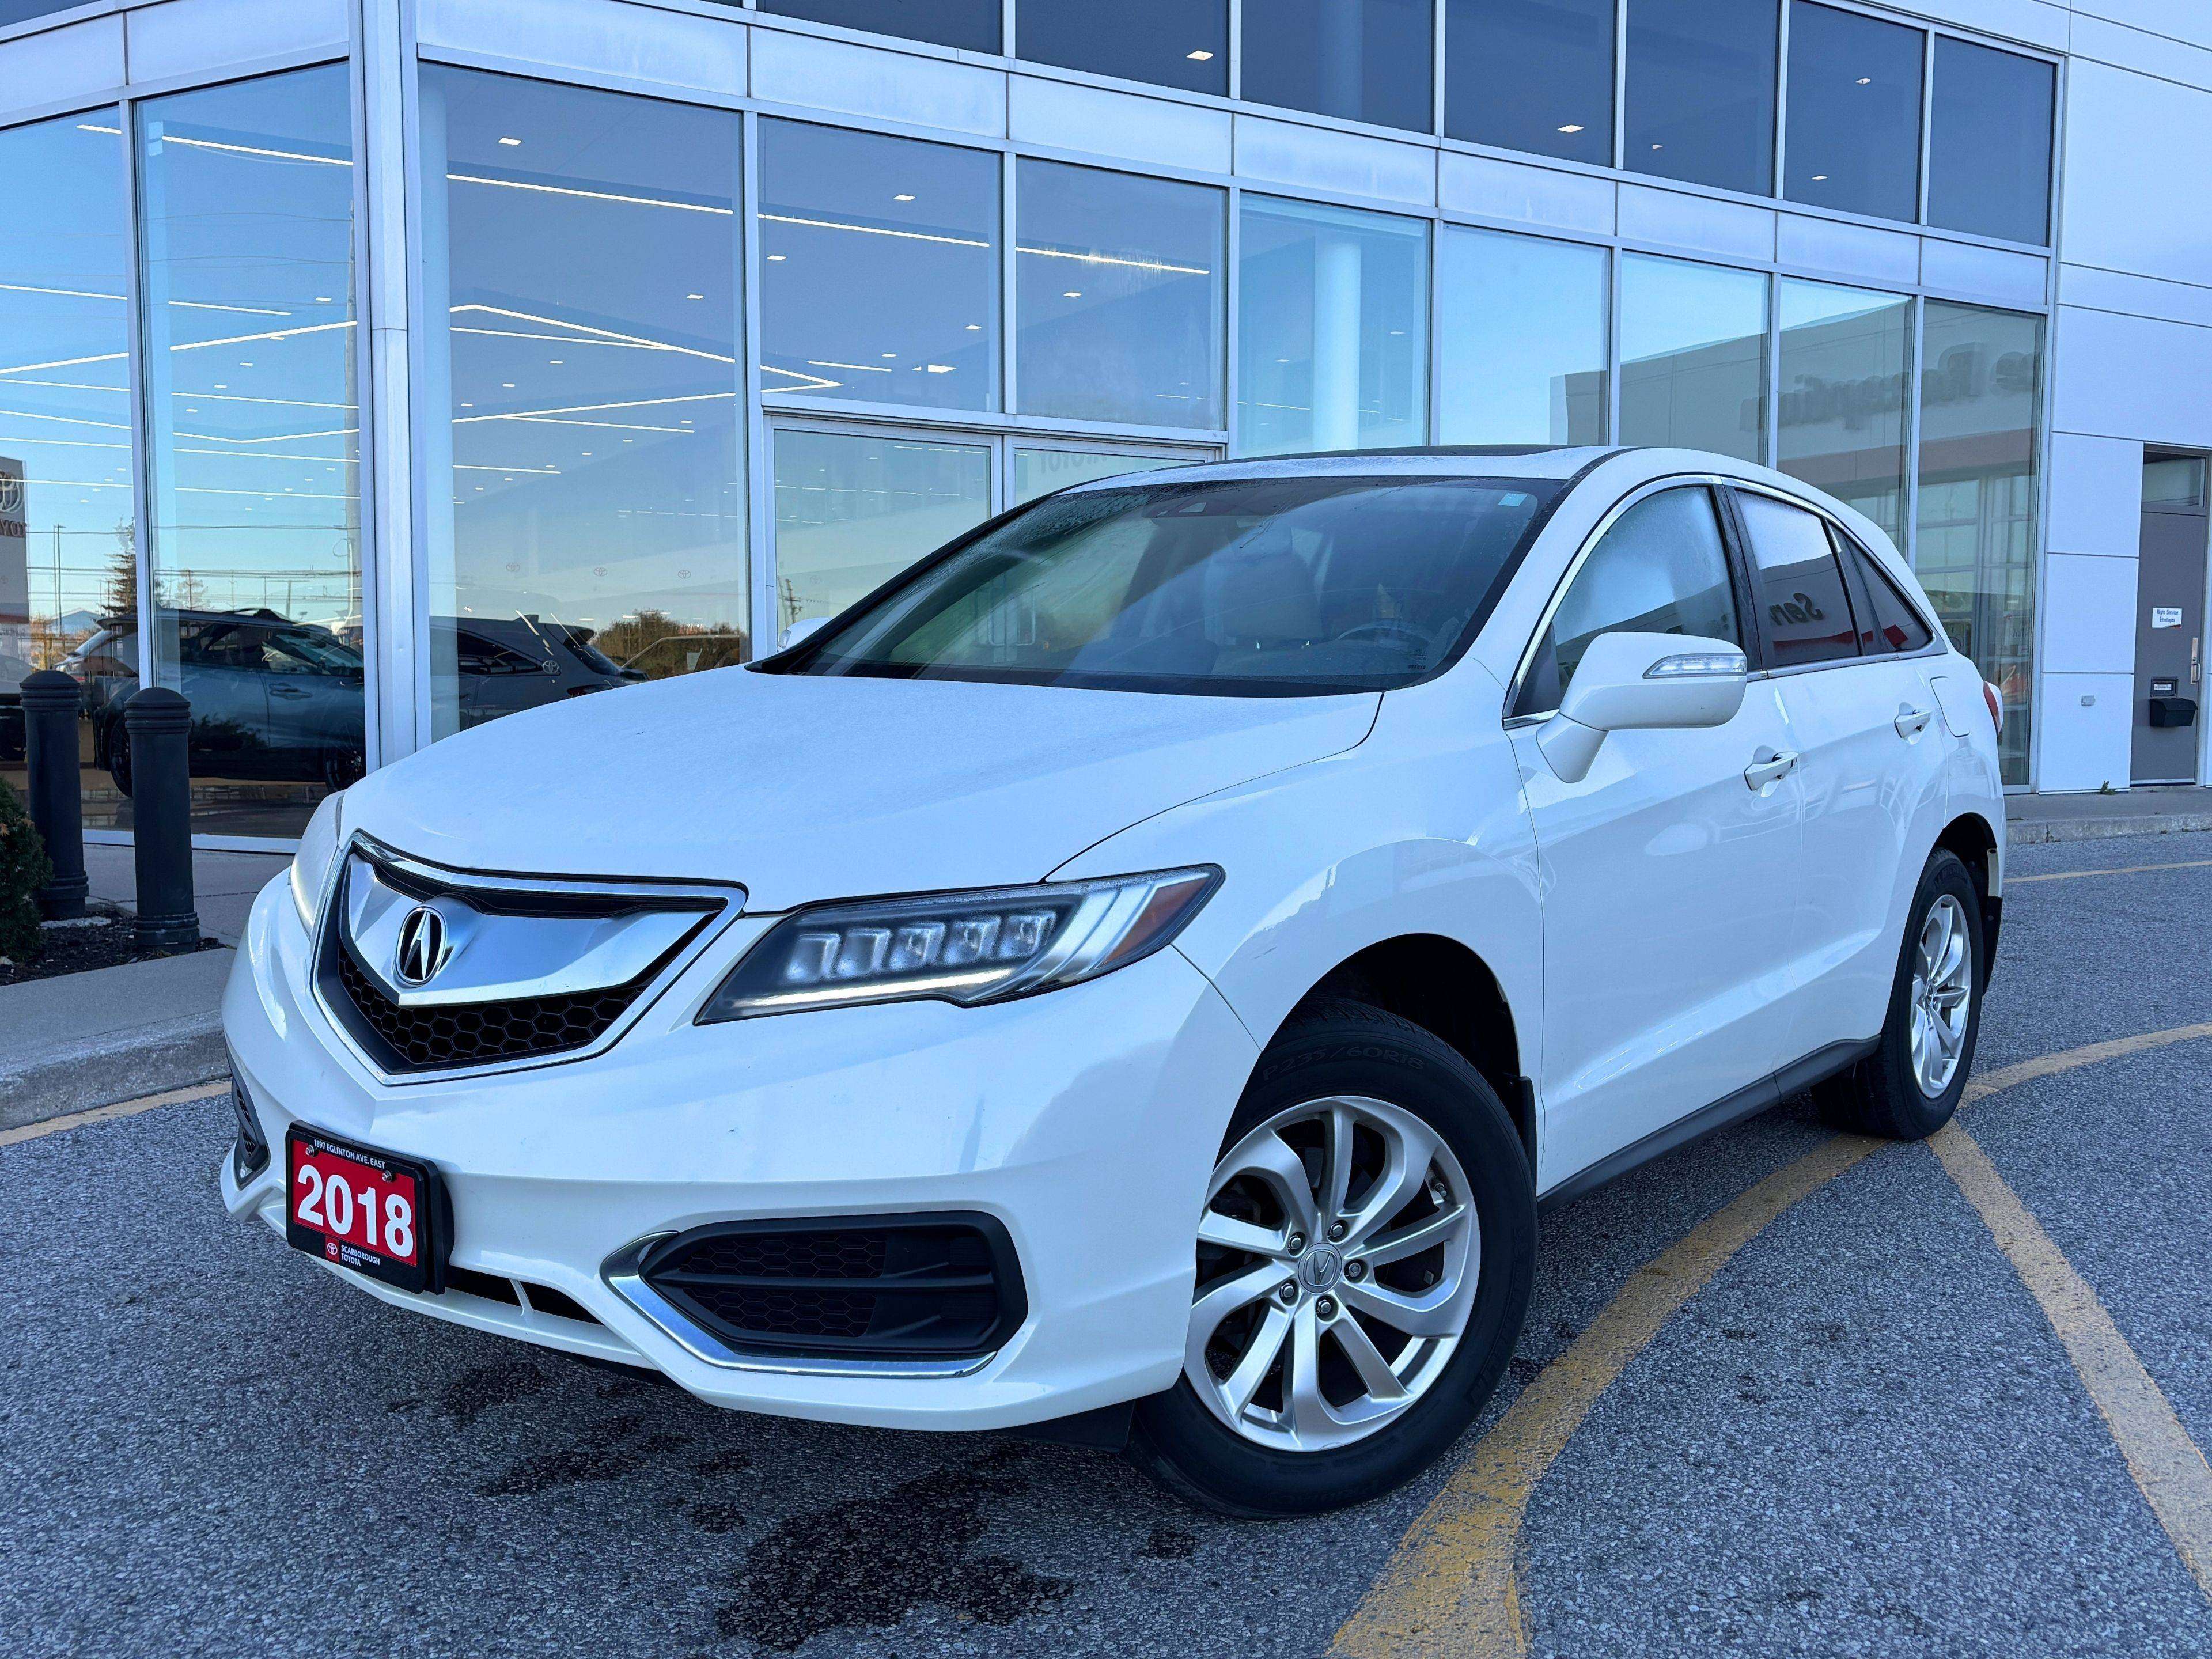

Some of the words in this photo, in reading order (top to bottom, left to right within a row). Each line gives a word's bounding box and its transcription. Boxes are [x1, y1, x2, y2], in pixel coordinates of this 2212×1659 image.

[1262, 1046, 1425, 1080] P235/60R18
[314, 1139, 325, 1149] 1897
[326, 1143, 355, 1160] EGLINTON
[355, 1153, 369, 1165] AVE.
[370, 1157, 385, 1169] EAST
[297, 1164, 414, 1257] 2018
[341, 1244, 380, 1266] SCARBOROUGH
[341, 1252, 361, 1267] TOYOTA
